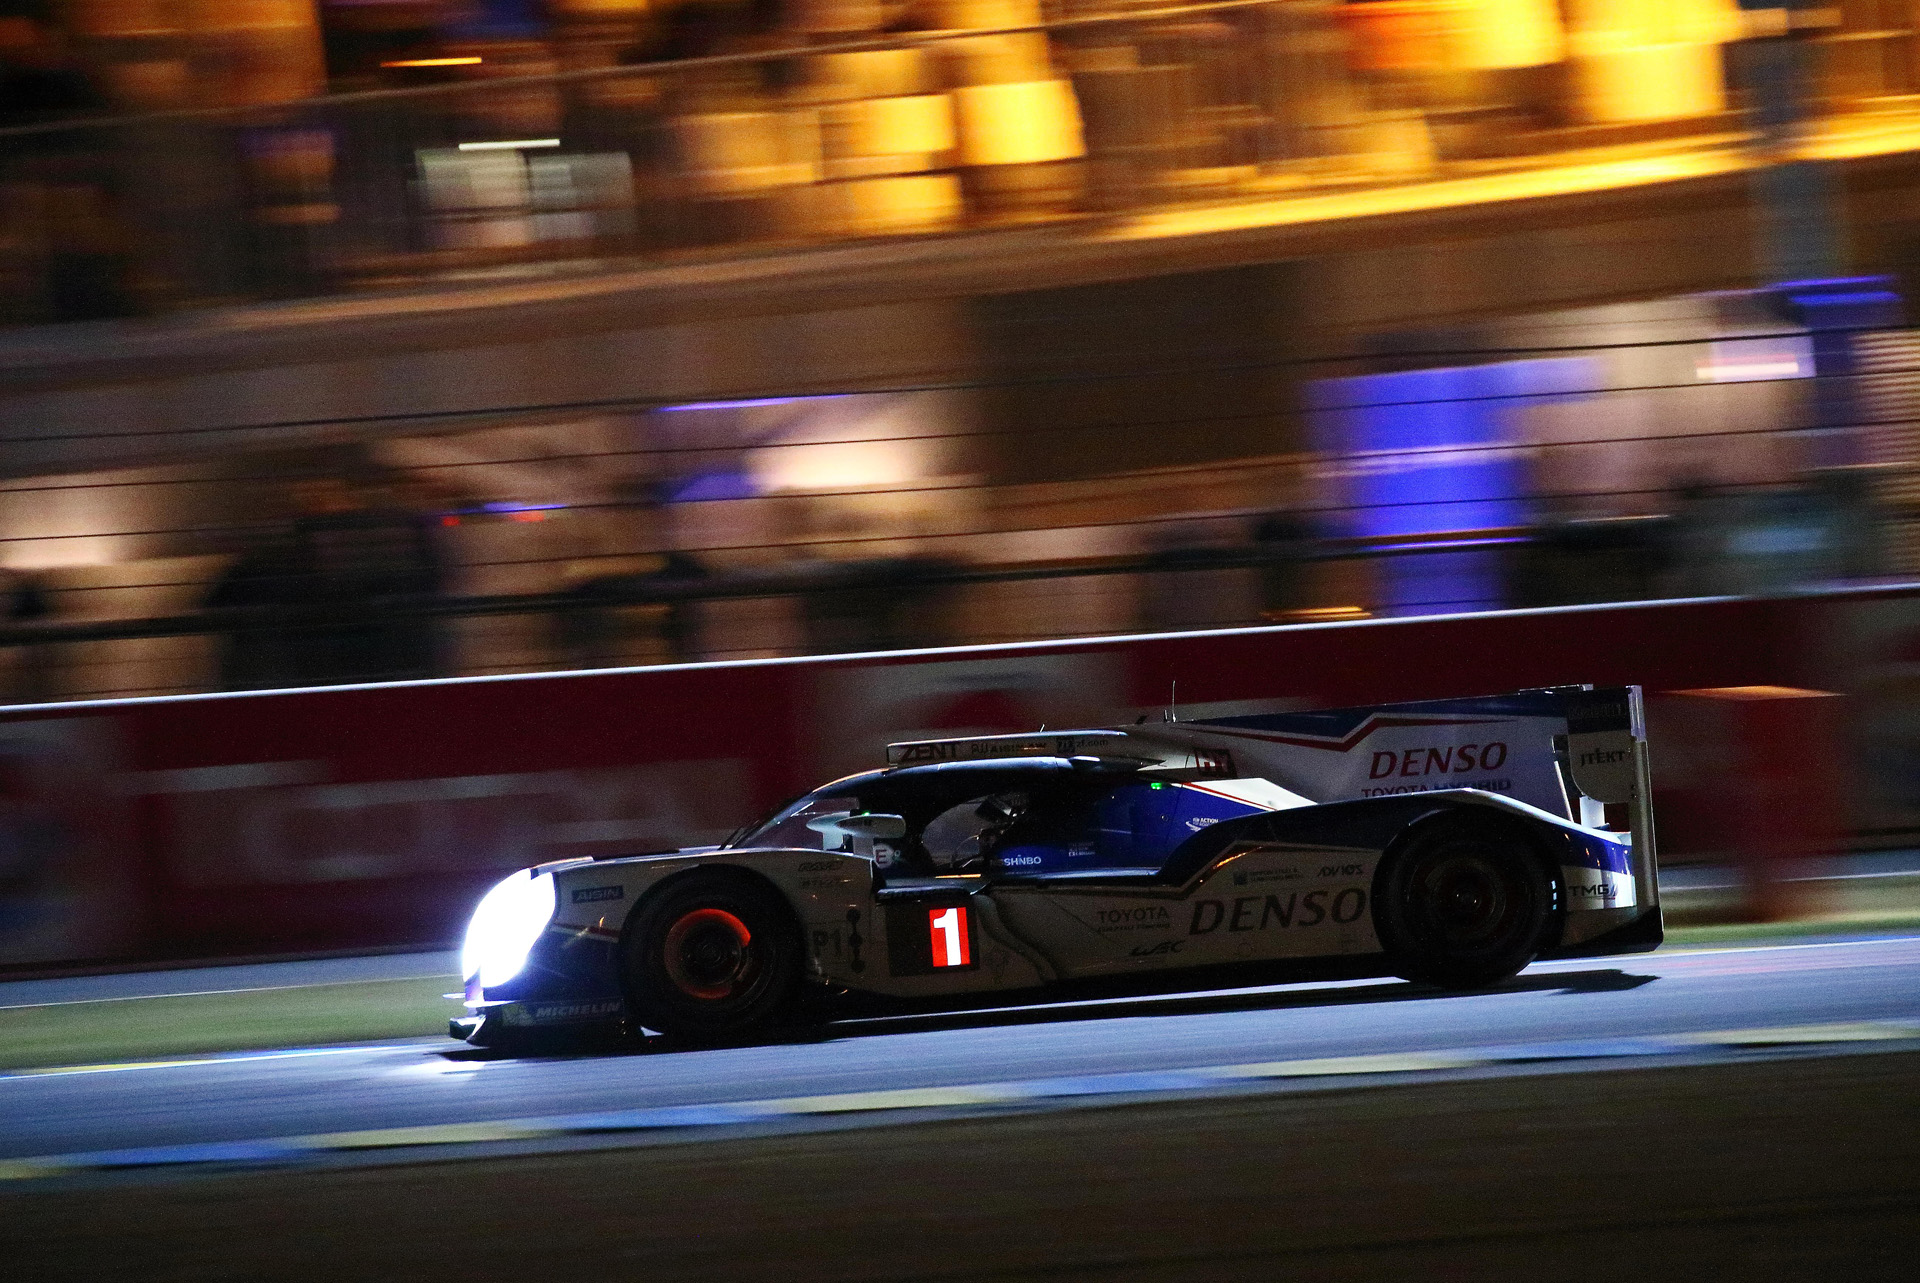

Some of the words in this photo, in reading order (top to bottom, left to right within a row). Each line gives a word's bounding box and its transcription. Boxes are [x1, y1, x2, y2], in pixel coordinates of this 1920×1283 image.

[901, 743, 959, 762] ZENT
[1369, 742, 1507, 780] DENSO
[1581, 748, 1625, 766] JTEKT
[576, 888, 621, 902] AISIN
[1097, 907, 1169, 923] TOYOTA
[1189, 888, 1367, 936] DENSO
[812, 929, 842, 958] P1
[933, 908, 962, 966] 1
[536, 1002, 621, 1018] MICHELIN
